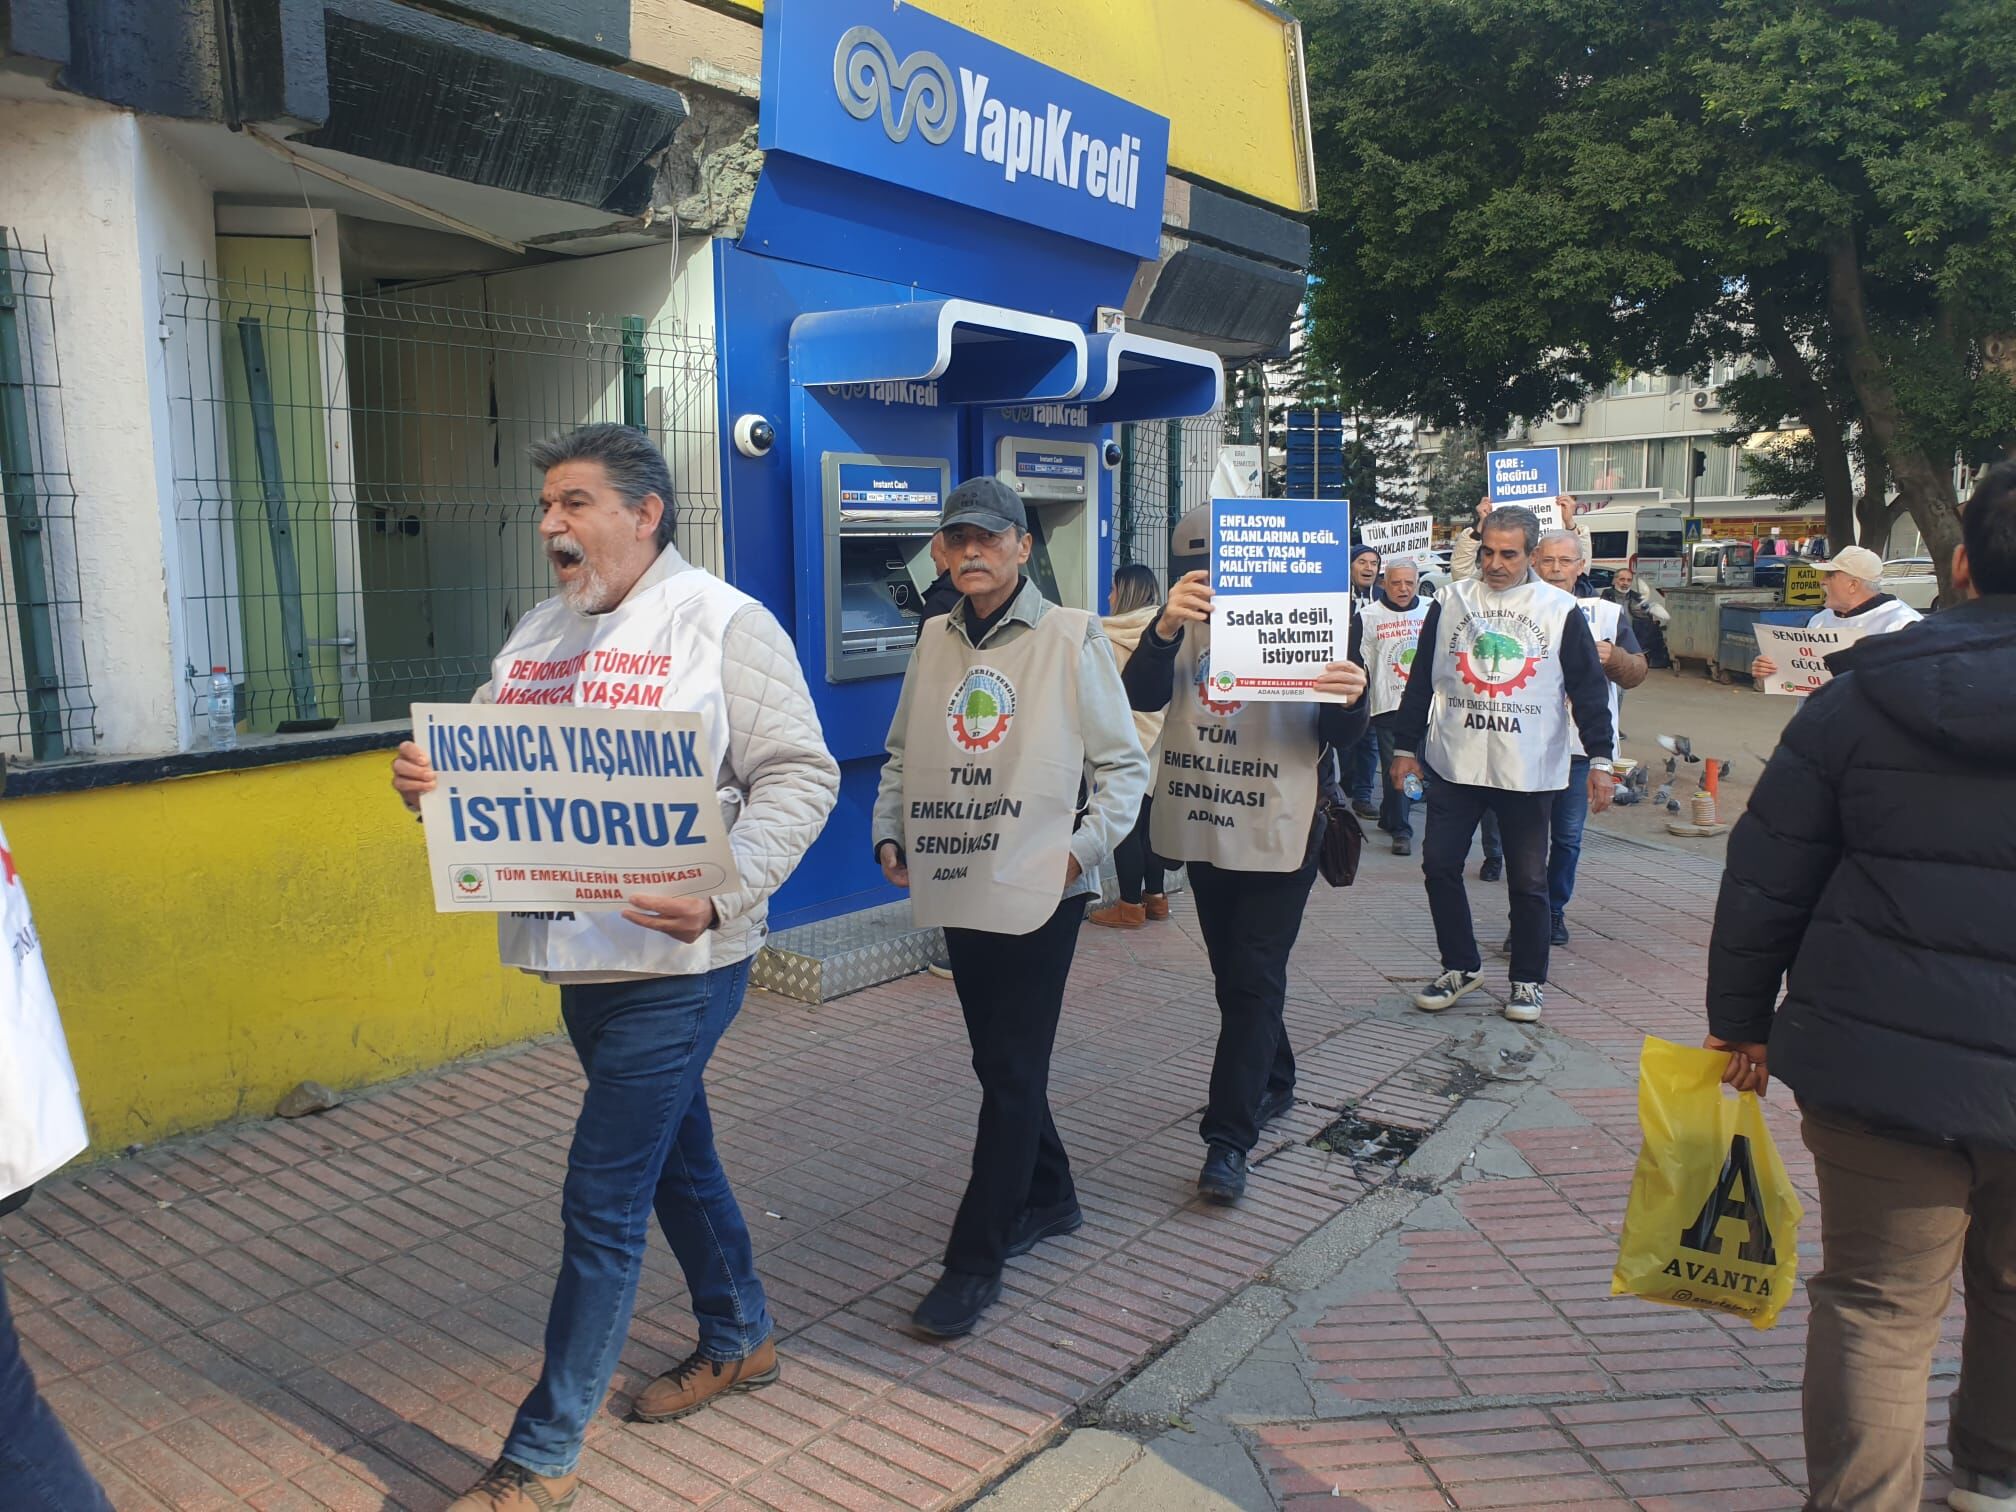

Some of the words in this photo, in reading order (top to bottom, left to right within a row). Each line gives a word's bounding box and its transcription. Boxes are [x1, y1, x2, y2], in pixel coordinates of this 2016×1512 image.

[959, 67, 1141, 209] YapıKredi
[1495, 458, 1518, 470] ÇARE
[1496, 468, 1538, 482] ÖRGÜTLÜ
[873, 480, 894, 489] Instant
[894, 480, 908, 489] Cash
[1496, 483, 1547, 496] MÜCADELE!
[1219, 515, 1286, 528] ENFLASYON
[1391, 520, 1428, 537] İKTİDARIN
[1219, 530, 1299, 544] YALANLARINA
[1302, 529, 1339, 546] DEĞİL,
[1408, 536, 1429, 551] BİZİM
[1219, 545, 1263, 560] GERÇEK
[1267, 546, 1306, 560] YAŞAM
[1219, 559, 1287, 573] MALİYETİNE
[1290, 560, 1322, 574] GÖRE
[1798, 570, 1816, 578] KATLI
[1219, 576, 1253, 588] AYLIK
[1226, 610, 1283, 626] Sadaka
[1288, 608, 1333, 626] değil,
[1258, 628, 1333, 644] hakkımızı
[1449, 632, 1459, 656] TÜM
[1518, 614, 1549, 660] SENDİKASI
[1772, 630, 1839, 643] SENDİKALI
[1262, 646, 1334, 665] istiyoruz!
[1800, 647, 1817, 657] OL
[508, 650, 590, 681] DEMOKRATİK
[593, 648, 672, 677] TÜRKİYE
[1808, 676, 1823, 686] OL
[496, 683, 576, 704] İNSANCA
[582, 681, 664, 709] YAŞAM
[1448, 696, 1465, 708] TÜM
[1466, 699, 1542, 715] EMEKLİLERİN-SEN
[1464, 713, 1522, 734] ADANA
[1197, 724, 1237, 745] TÜM
[428, 714, 558, 773] İNSANCA
[559, 725, 704, 781] YAŞAMAK
[1164, 750, 1279, 779] EMEKLİLERİN
[950, 762, 992, 786] TÜM
[1168, 780, 1265, 808] SENDİKASI
[910, 794, 1022, 820] EMEKLİLERİN
[449, 787, 707, 847] İSTİYORUZ
[1188, 810, 1235, 828] ADANA
[915, 832, 1000, 855] SENDİKASI
[495, 867, 526, 881] TÜM
[530, 868, 618, 885] EMEKLİLERİN
[622, 868, 702, 884] SENDİKASI
[932, 866, 968, 881] ADANA
[575, 887, 623, 900] ADANA
[1680, 1134, 1777, 1266] A
[1662, 1258, 1770, 1297] AVANTA
